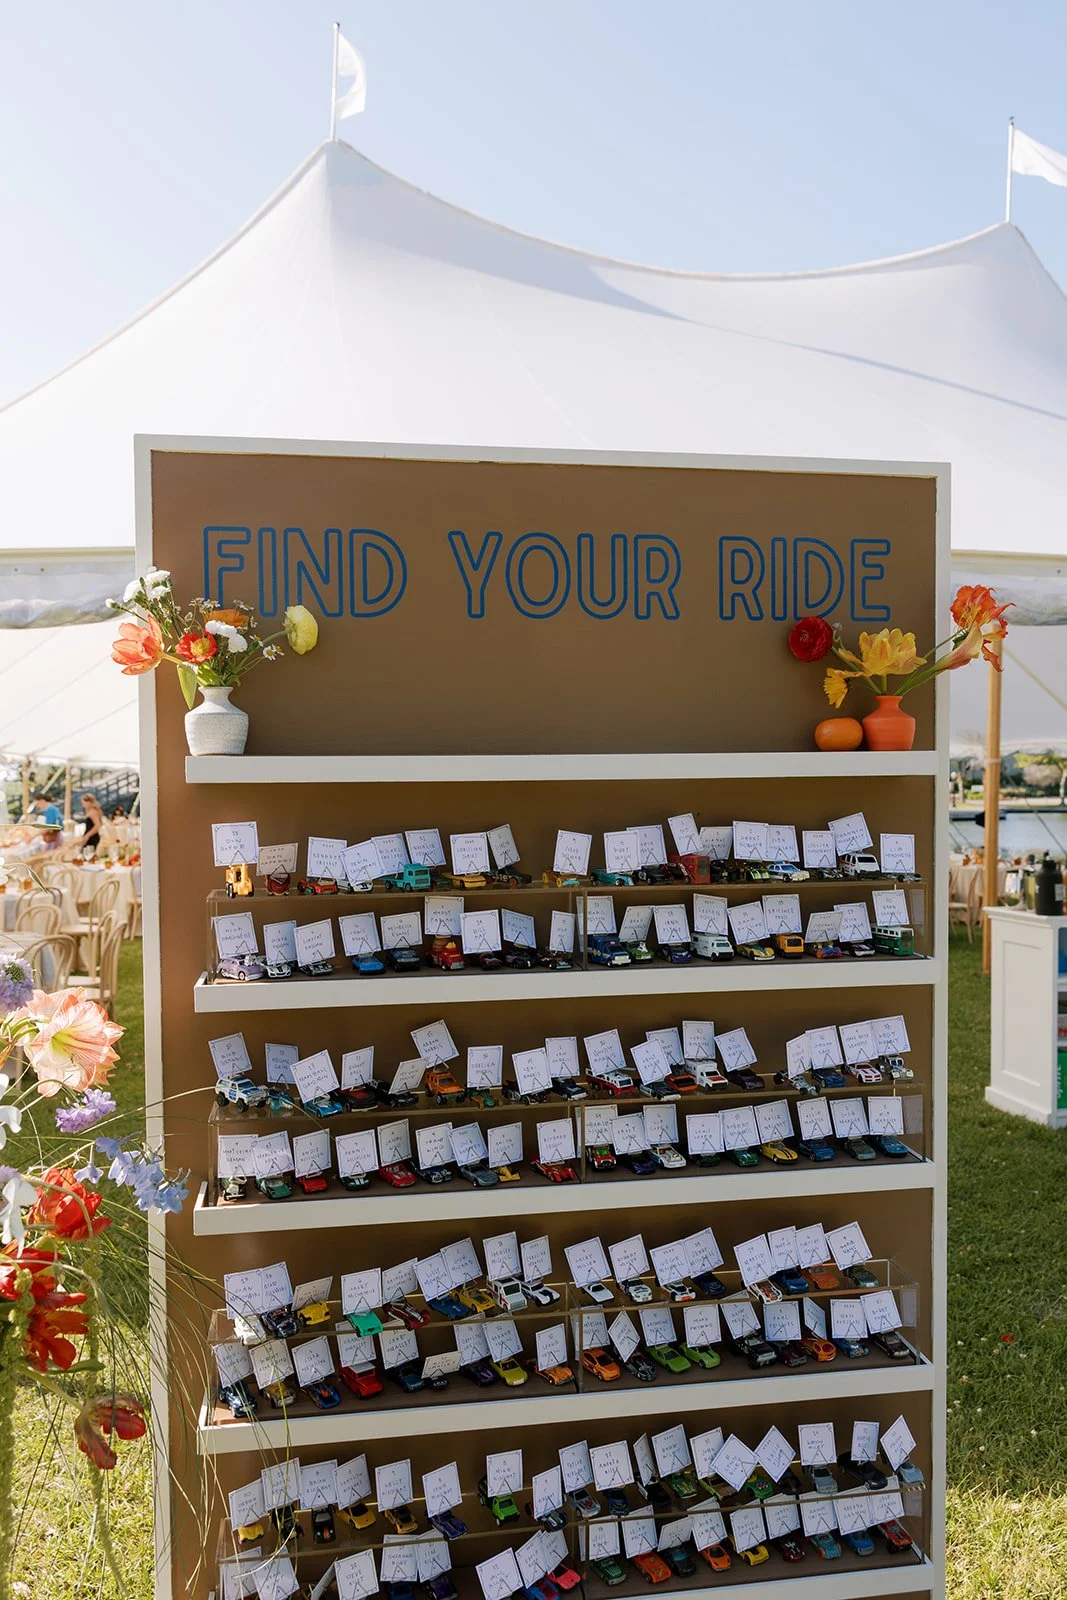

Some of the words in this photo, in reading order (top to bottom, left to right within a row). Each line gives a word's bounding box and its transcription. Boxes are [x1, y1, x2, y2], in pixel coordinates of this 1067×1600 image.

[203, 526, 408, 618] FIND
[447, 530, 681, 620] YOUR
[718, 535, 891, 622] RIDE
